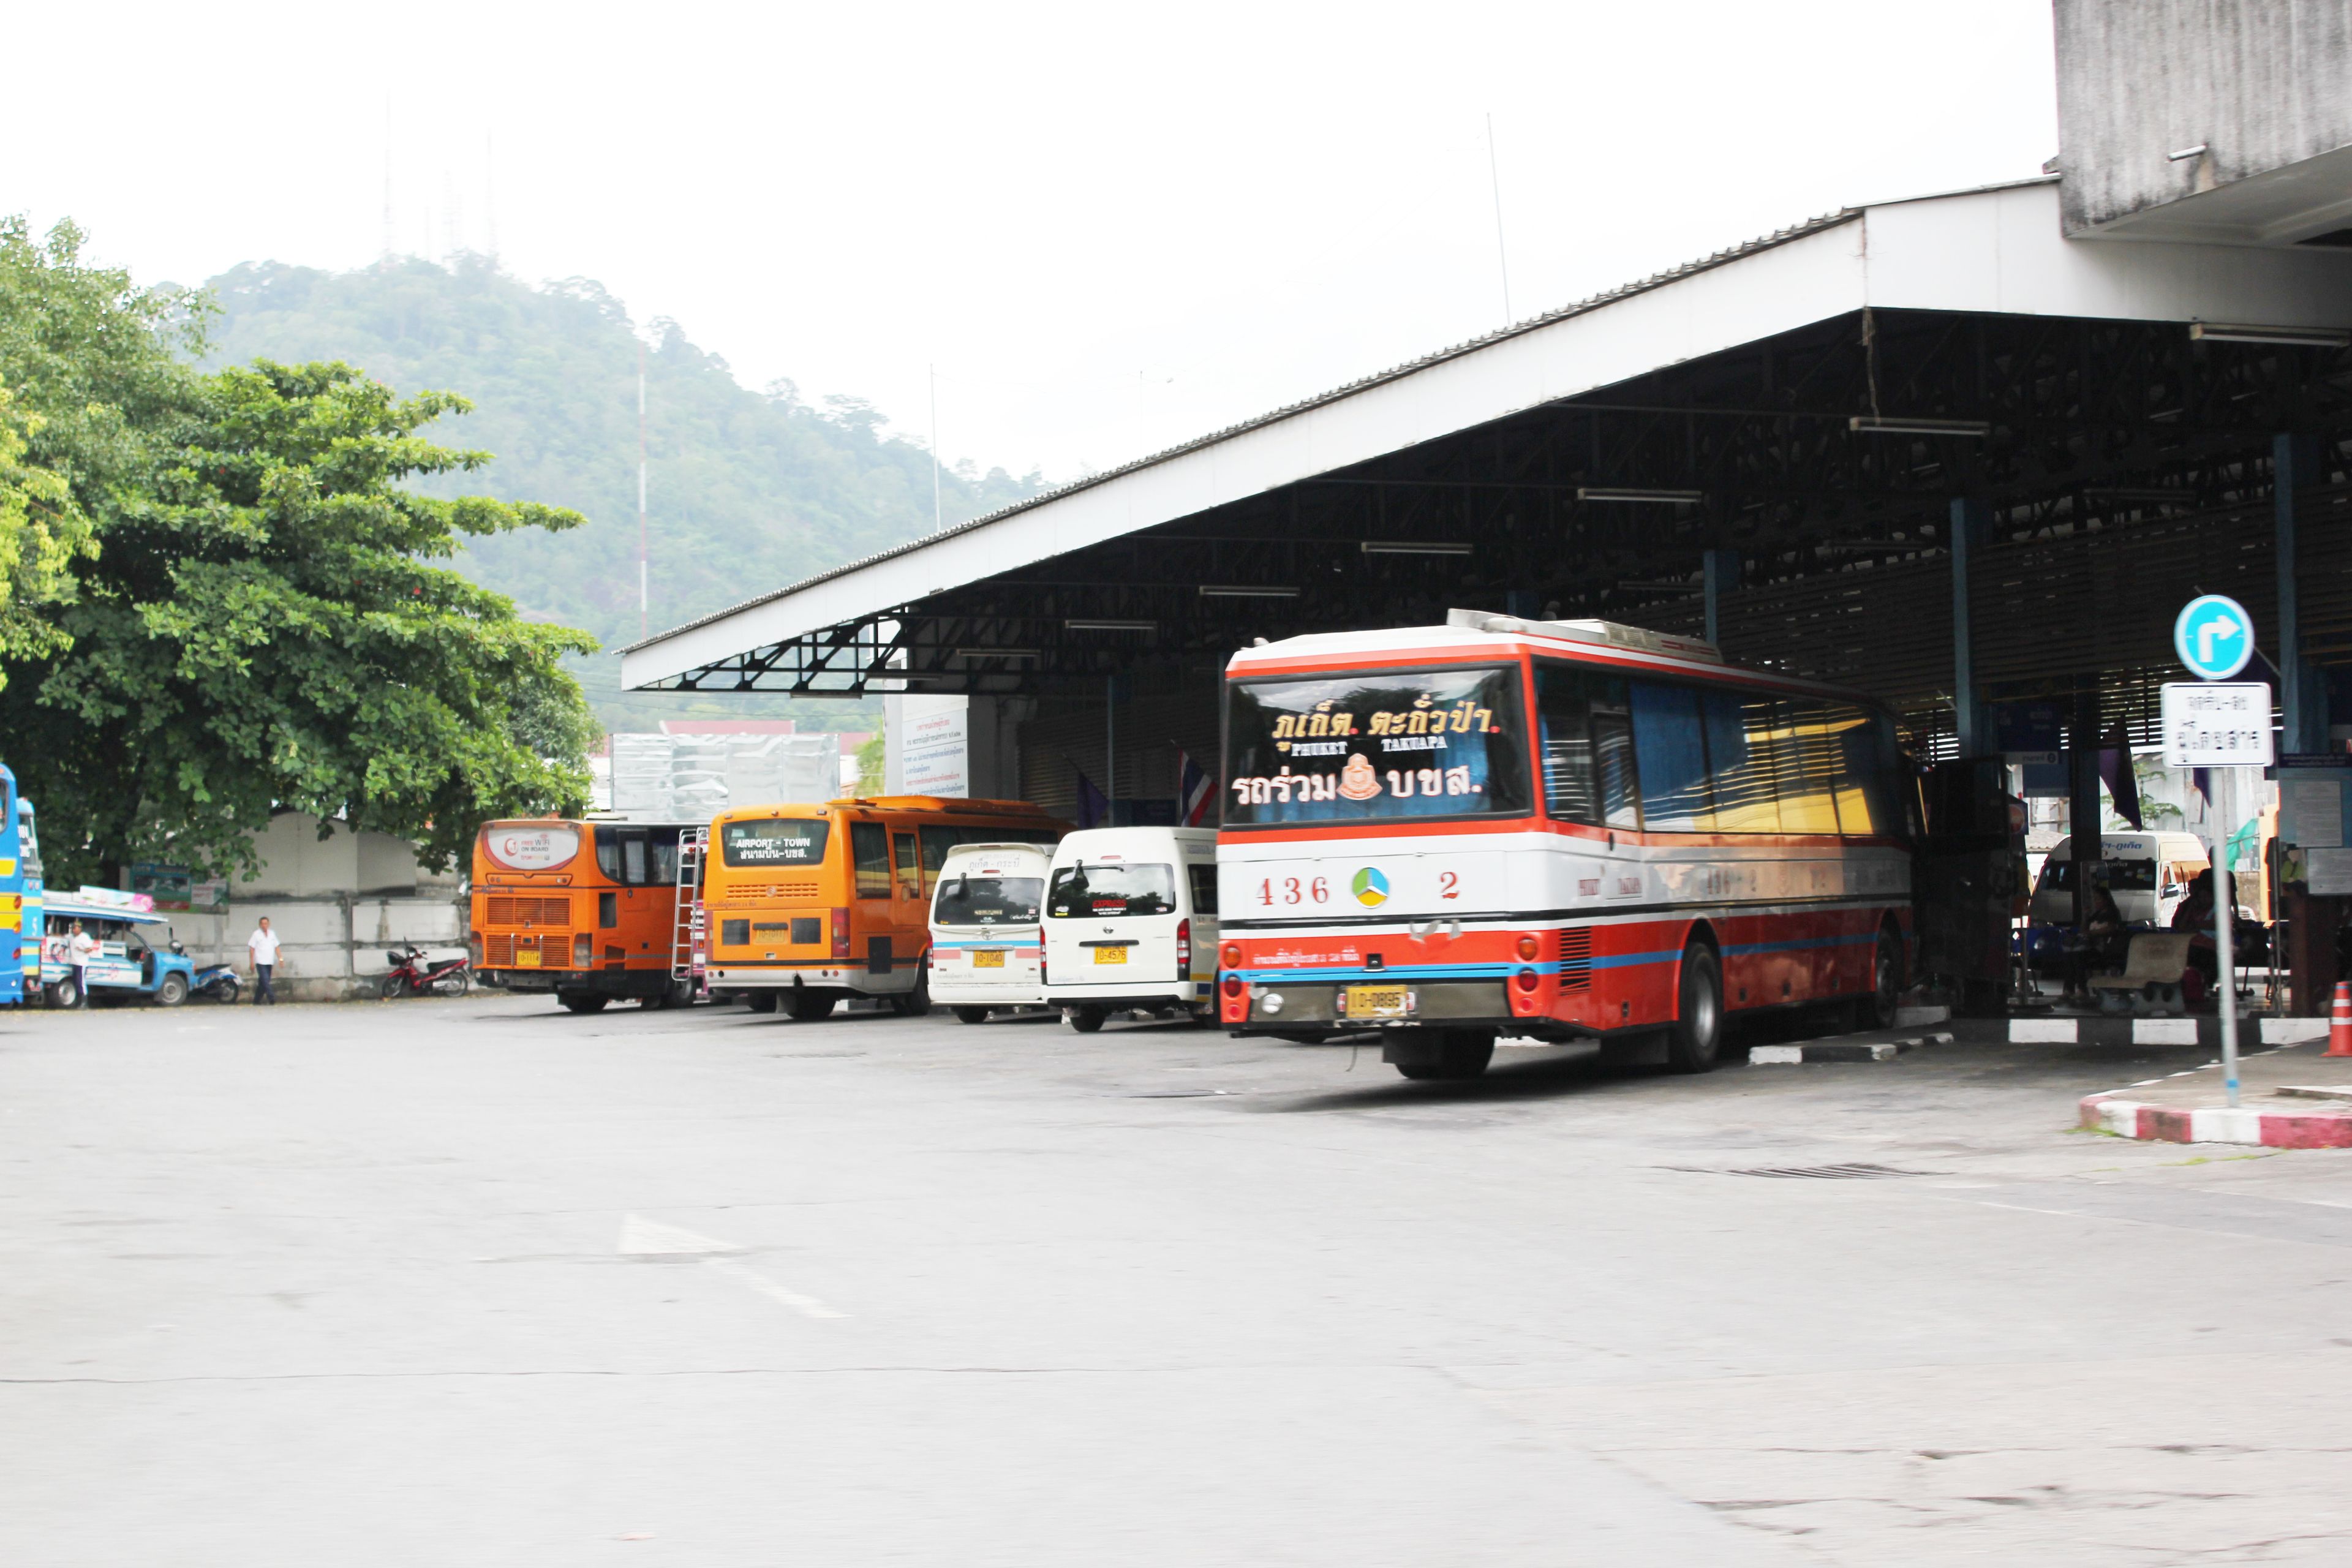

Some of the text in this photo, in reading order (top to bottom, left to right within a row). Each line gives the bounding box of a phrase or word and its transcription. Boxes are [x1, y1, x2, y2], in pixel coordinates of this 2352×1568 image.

[1291, 736, 1448, 756] PHUKET TAKUAPA
[1231, 765, 1483, 805] รถร่วม บขส.
[736, 839, 774, 848] AIRPORT
[783, 838, 811, 847] TOWN
[1439, 872, 1460, 899] 2
[1092, 899, 1127, 908] EXPRESS
